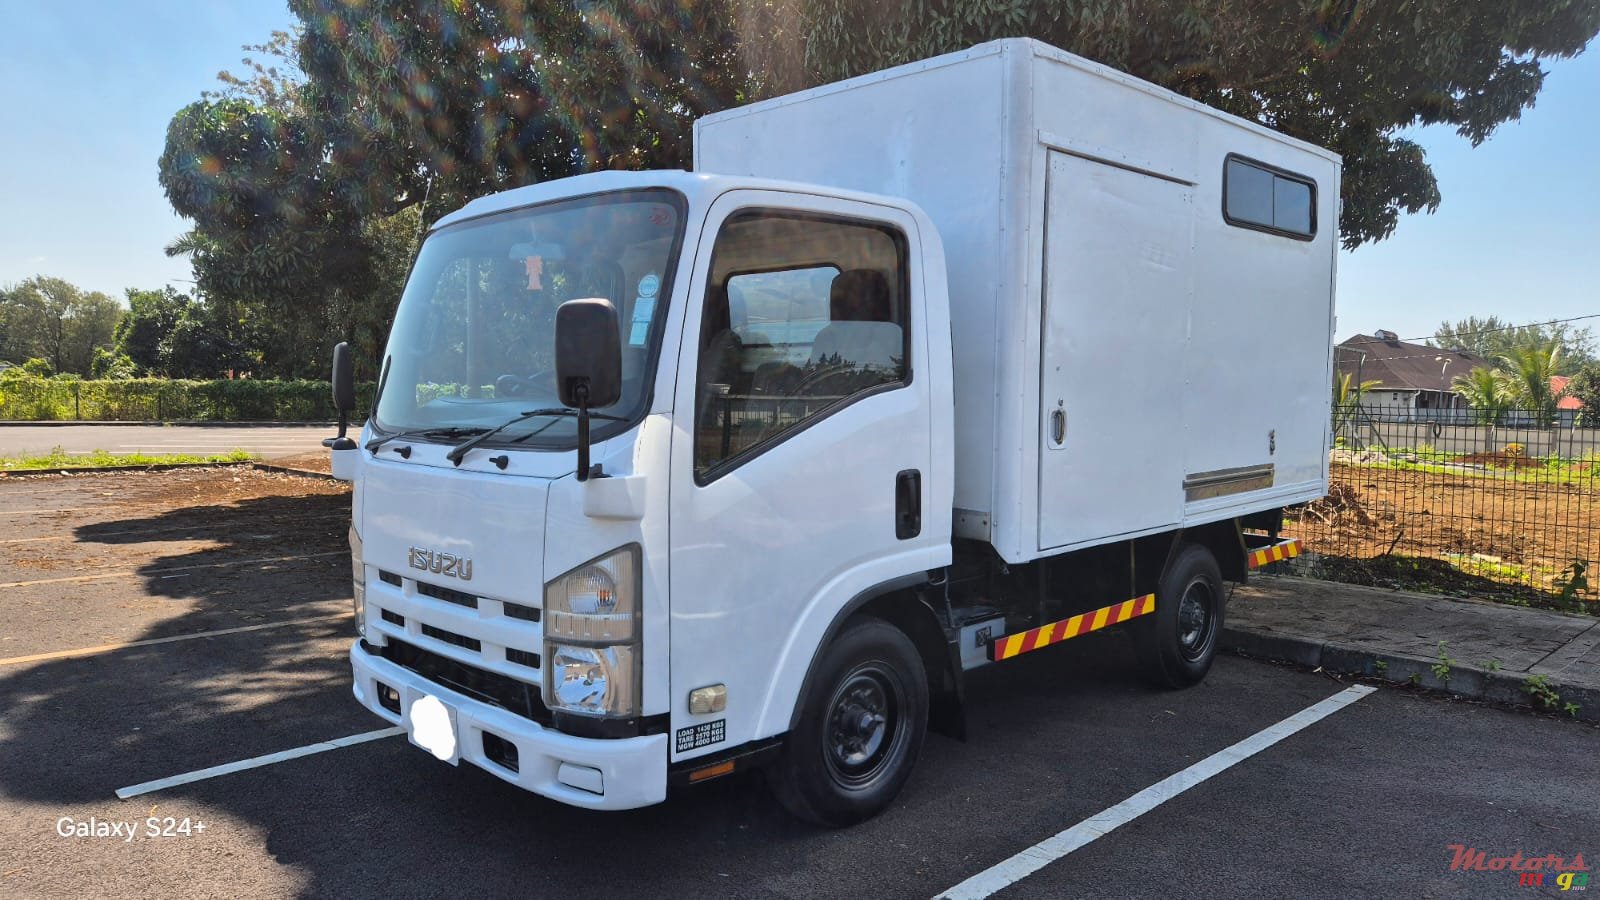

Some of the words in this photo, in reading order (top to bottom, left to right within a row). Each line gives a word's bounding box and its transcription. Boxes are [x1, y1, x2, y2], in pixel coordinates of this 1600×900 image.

[408, 545, 473, 581] ISUZU
[678, 728, 694, 738] LOAD
[712, 721, 724, 729] KGS
[678, 735, 694, 744] TARE
[711, 727, 724, 736] KGS
[677, 742, 694, 751] MGW
[695, 737, 711, 746] 4000
[711, 734, 724, 743] KGS
